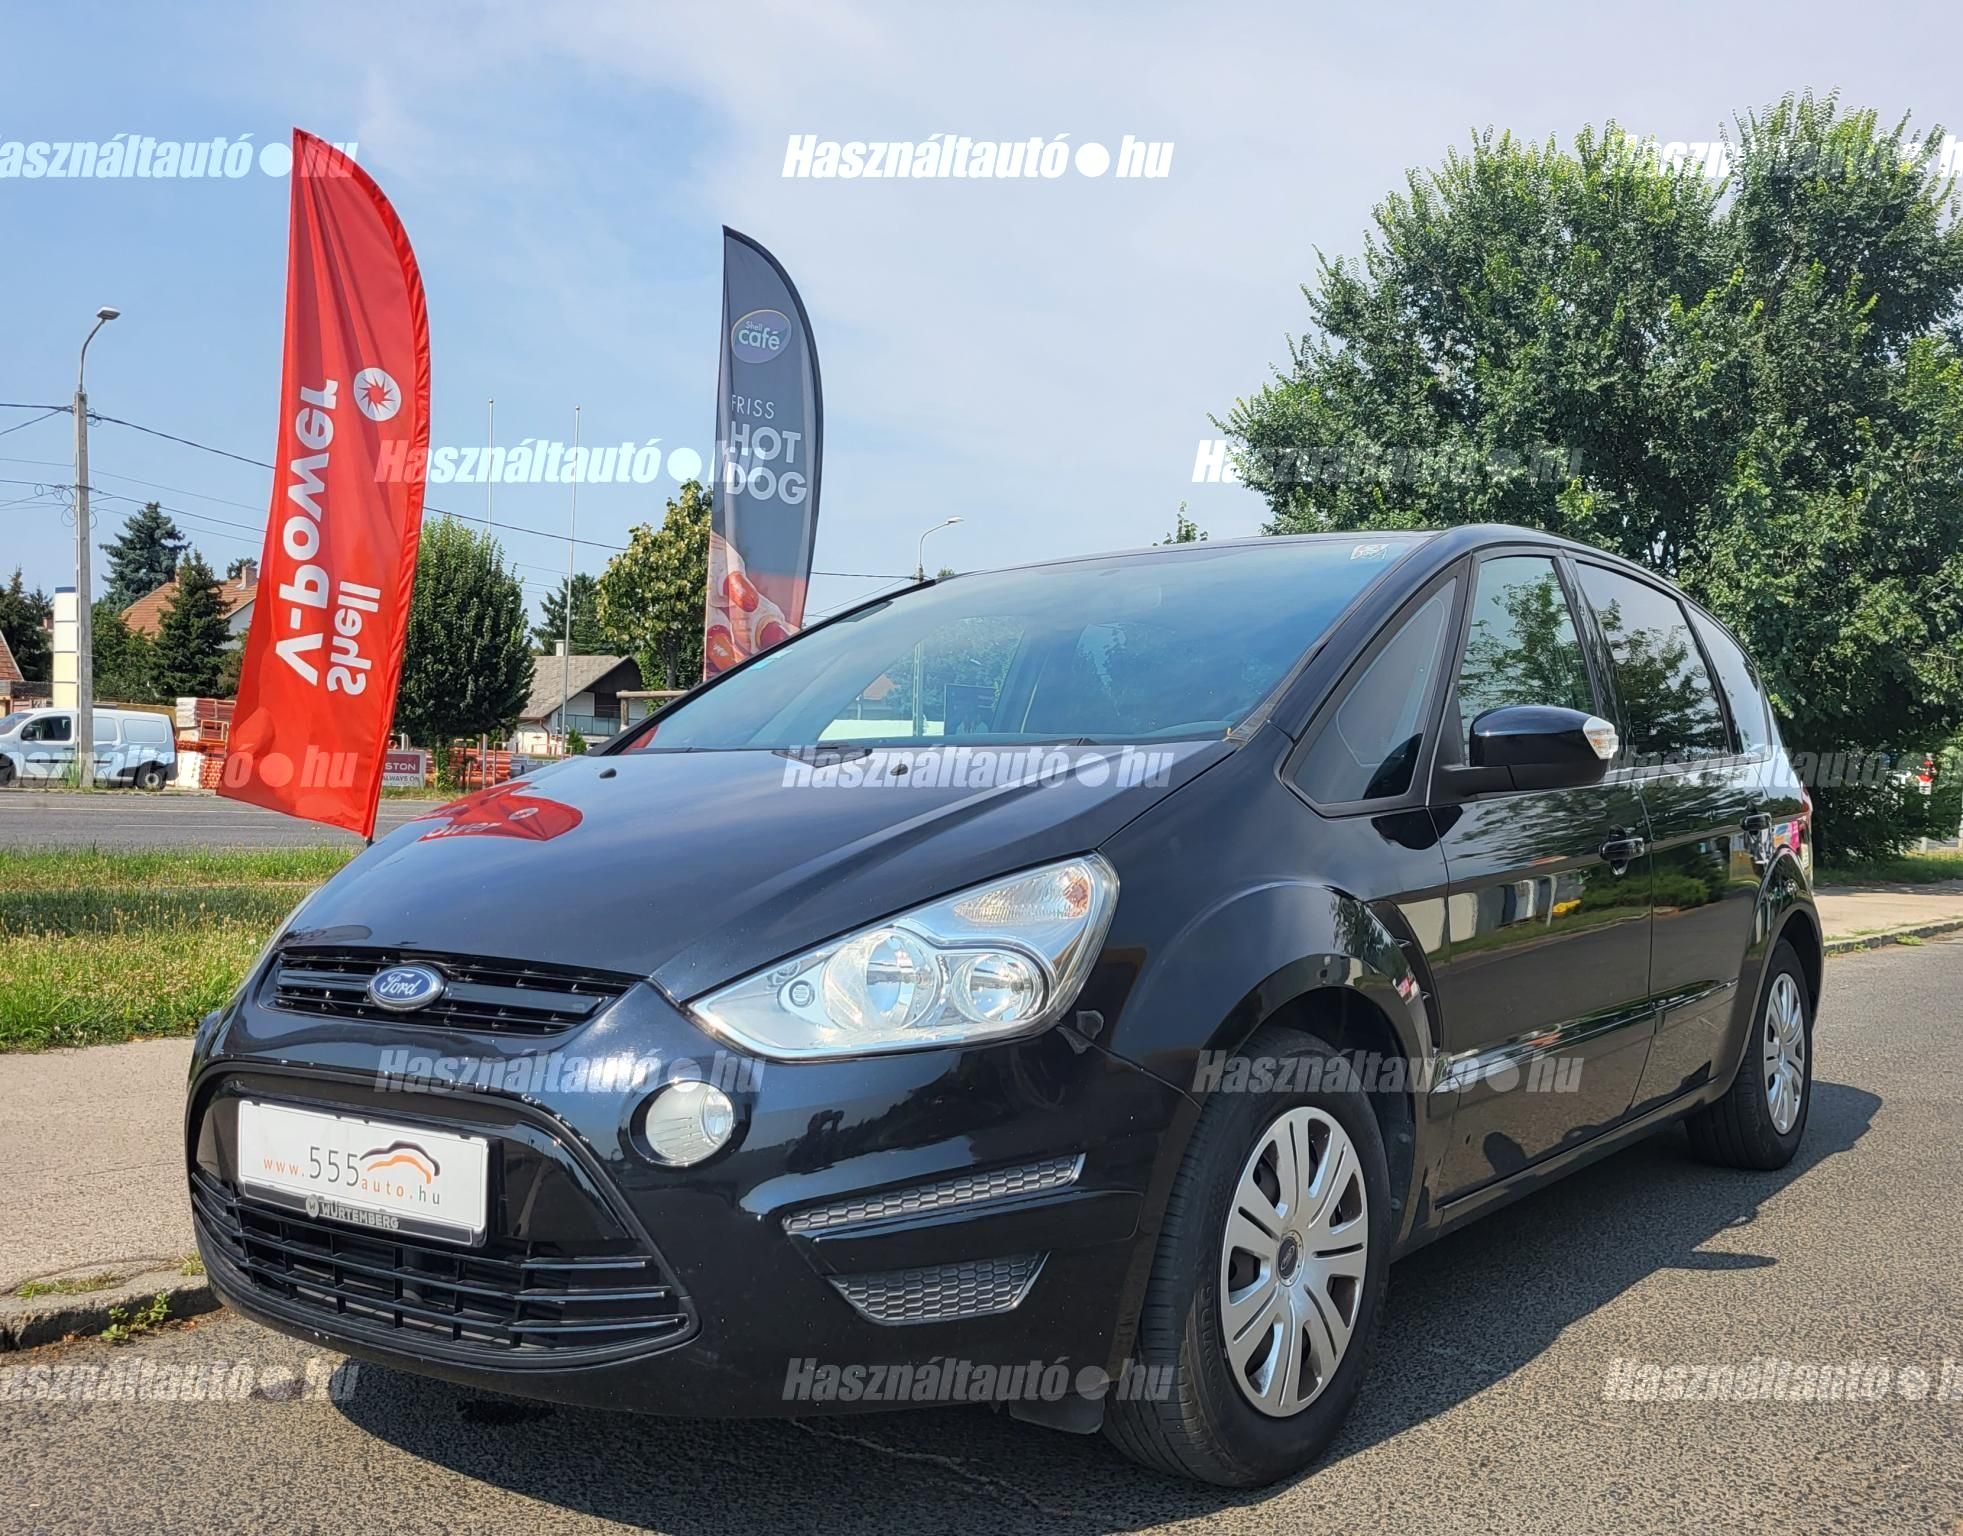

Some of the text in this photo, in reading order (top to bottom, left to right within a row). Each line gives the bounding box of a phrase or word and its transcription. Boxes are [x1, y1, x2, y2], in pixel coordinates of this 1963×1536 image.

[738, 328, 780, 351] café
[731, 394, 775, 420] FRISS
[729, 421, 802, 464] HOT
[726, 461, 808, 505] DOG
[380, 972, 423, 996] Ford
